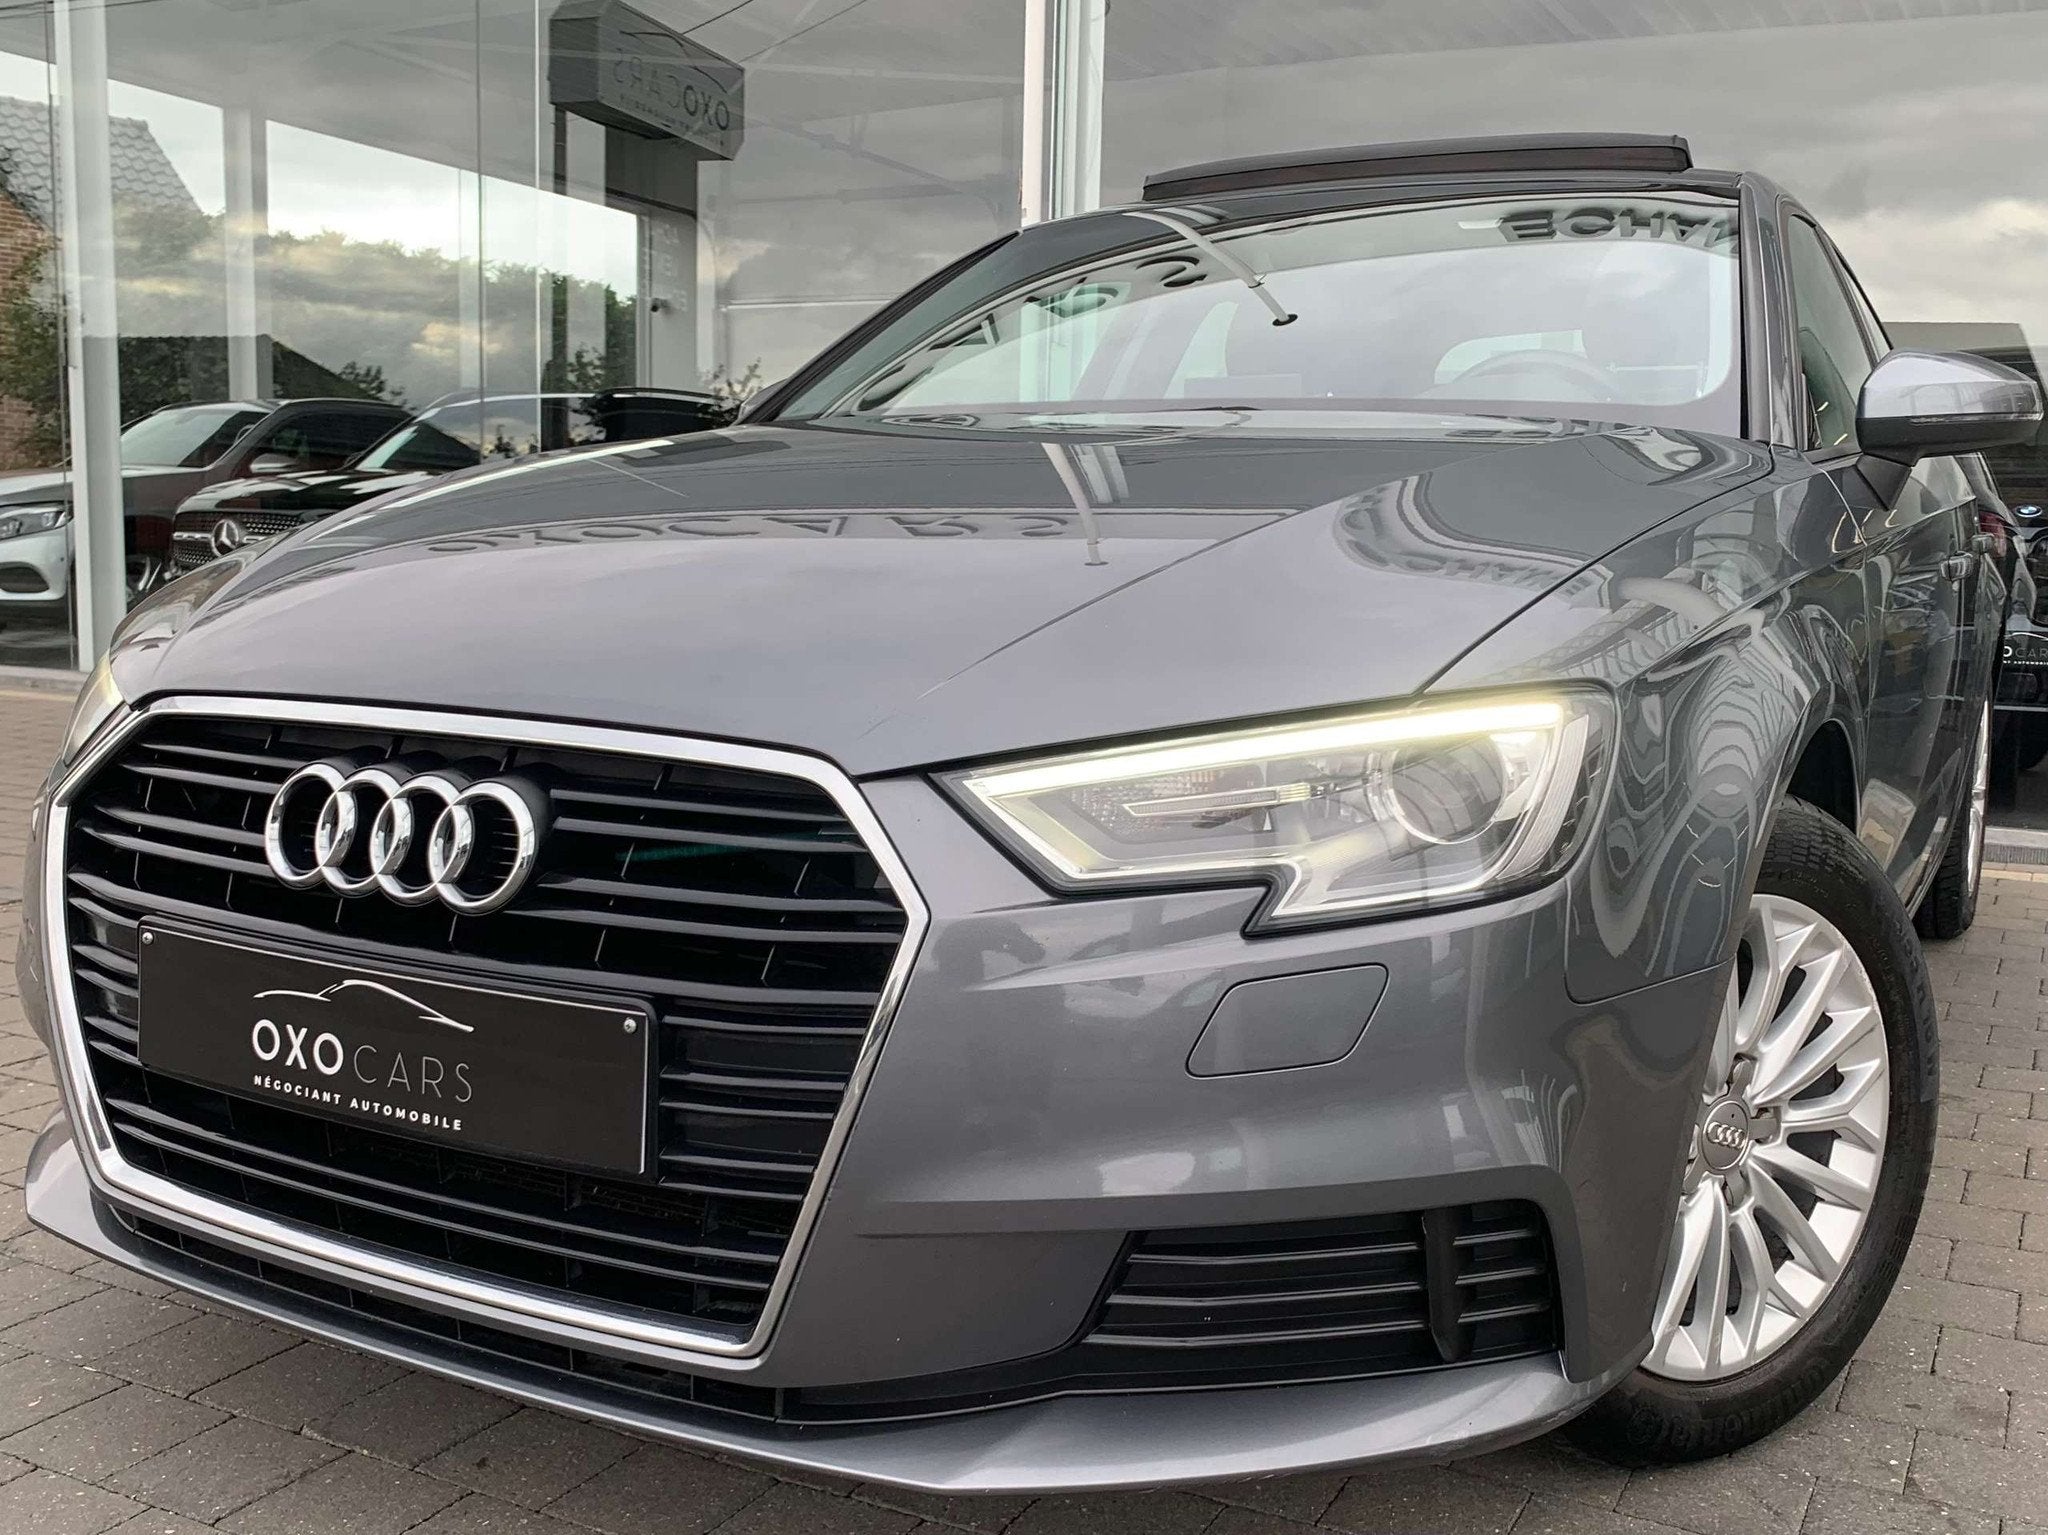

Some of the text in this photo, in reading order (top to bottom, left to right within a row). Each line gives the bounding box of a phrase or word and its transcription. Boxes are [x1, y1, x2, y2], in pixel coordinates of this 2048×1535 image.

[252, 1018, 474, 1103] OXO CARS
[254, 1073, 463, 1131] NÉGOCIANT AUTOMOBILE
